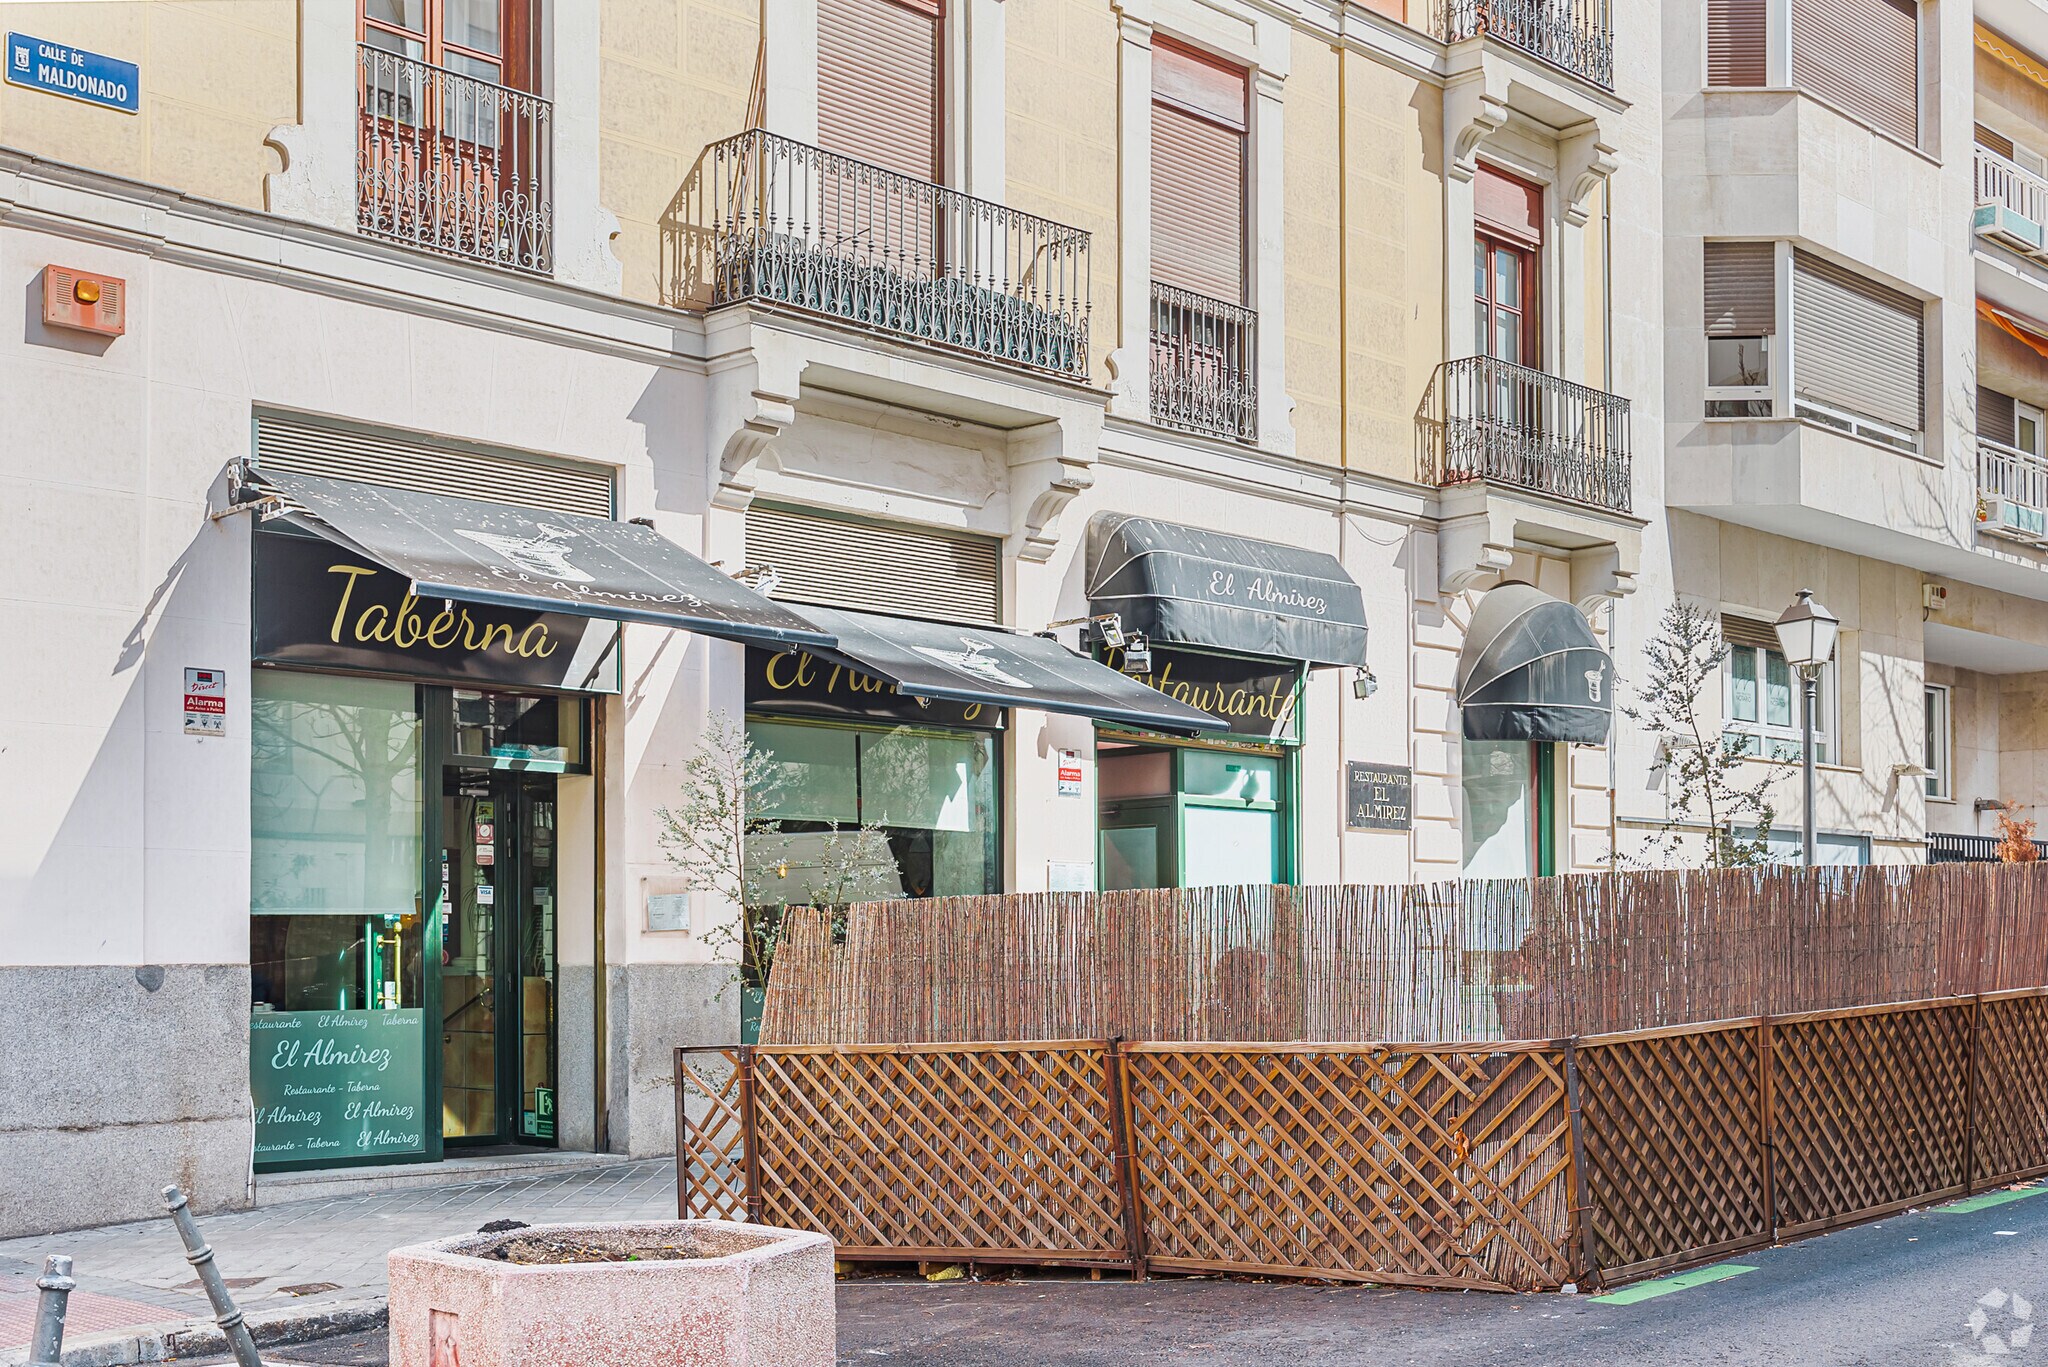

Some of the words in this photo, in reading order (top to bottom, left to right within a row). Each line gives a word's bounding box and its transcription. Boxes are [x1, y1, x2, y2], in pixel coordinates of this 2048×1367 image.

[38, 44, 67, 63] CALLE
[71, 52, 84, 67] DE
[38, 63, 127, 102] MALDONADO
[1209, 570, 1235, 596] El
[1246, 577, 1327, 615] Almirez
[327, 564, 559, 658] Taberna
[187, 697, 224, 708] Alarma
[1354, 770, 1408, 786] RESTAURANTE
[1373, 786, 1390, 802] EL
[1356, 803, 1407, 820] ALMIREZ
[250, 1018, 302, 1029] estaurante
[318, 1015, 329, 1028] El
[331, 1015, 369, 1029] Almirez
[382, 1013, 419, 1026] Taberna
[271, 1039, 300, 1070] El
[303, 1038, 393, 1072] Almirez
[284, 1084, 336, 1096] Restaurante
[347, 1081, 381, 1093] Taberna
[267, 1106, 323, 1126] Almirez
[344, 1102, 362, 1121] El
[363, 1101, 415, 1121] Almirez
[254, 1140, 295, 1152] staurante
[306, 1137, 341, 1149] Taberna
[356, 1130, 371, 1148] El
[373, 1129, 421, 1147] Almirez
